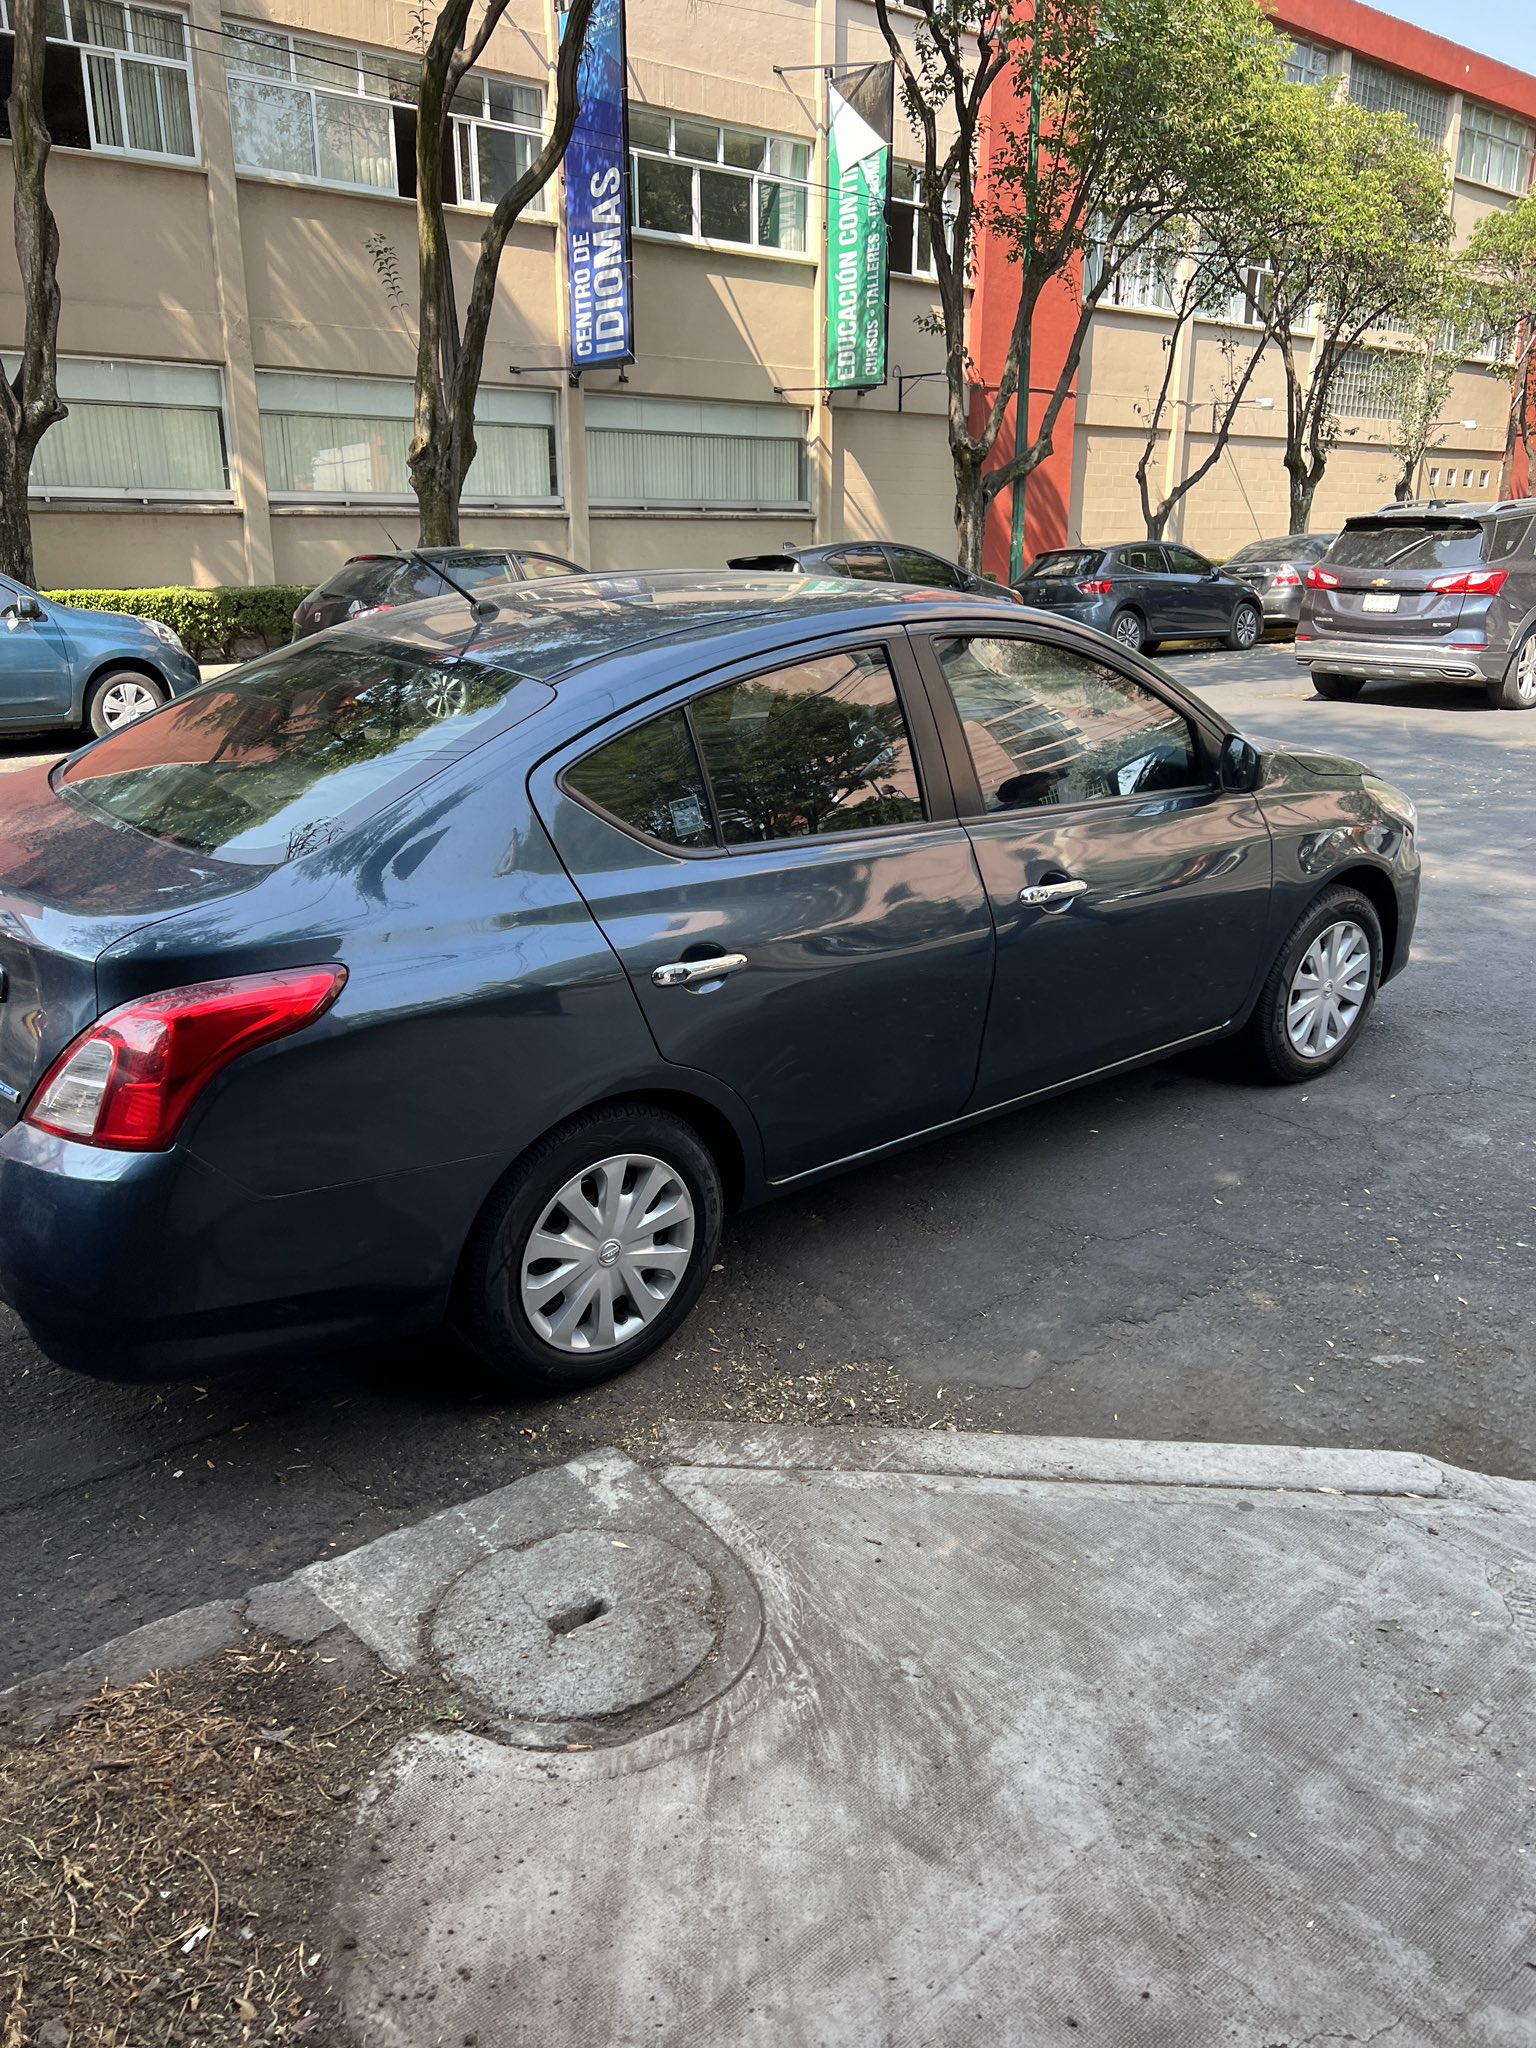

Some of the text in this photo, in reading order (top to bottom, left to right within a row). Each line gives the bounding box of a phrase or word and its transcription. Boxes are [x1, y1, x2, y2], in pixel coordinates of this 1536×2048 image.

[573, 231, 592, 357] CENTRO DE
[591, 166, 625, 354] IDIOMAS
[835, 249, 858, 381] EDUCACIÓN
[866, 233, 880, 308] TALLERES
[865, 319, 879, 376] CURSOS
